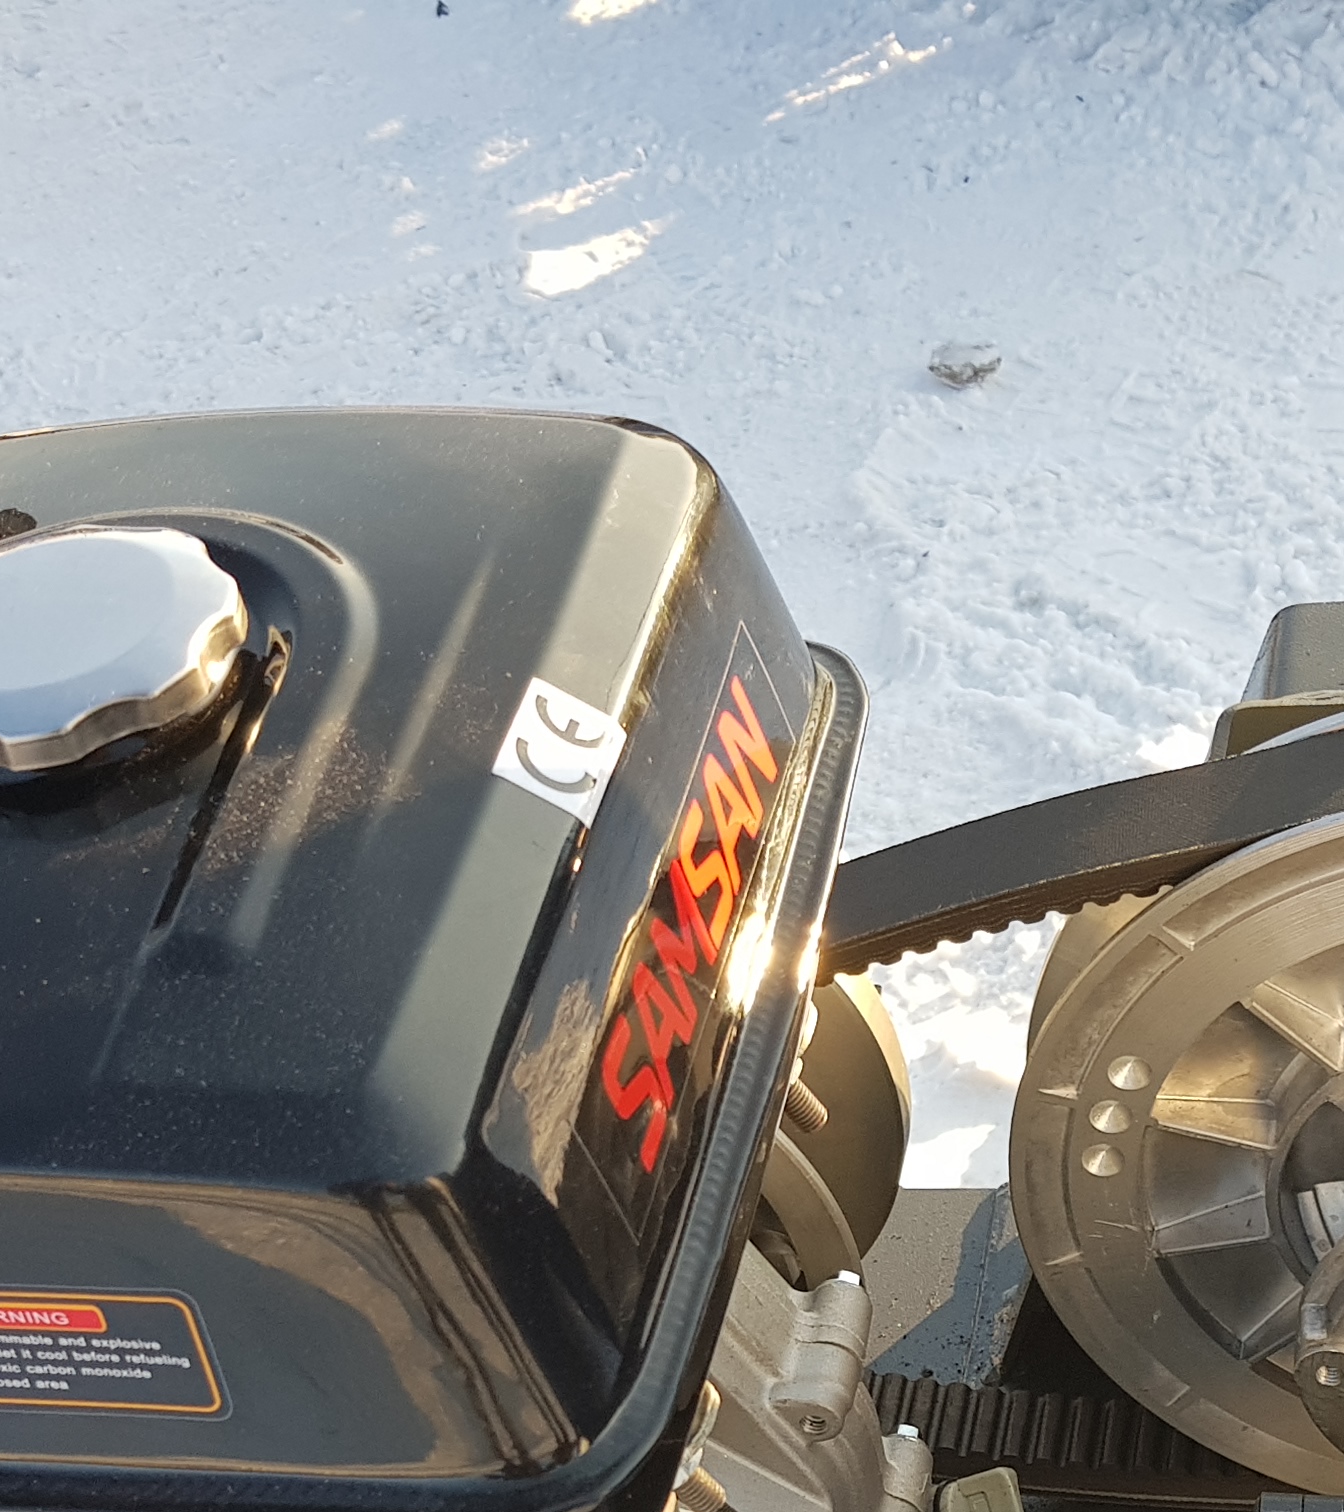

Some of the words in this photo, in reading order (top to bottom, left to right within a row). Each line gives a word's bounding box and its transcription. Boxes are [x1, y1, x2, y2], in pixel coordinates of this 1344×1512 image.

[516, 694, 605, 794] CE
[602, 675, 779, 1174] SAMSAN
[58, 1336, 87, 1347] and
[91, 1337, 161, 1350] explosive
[21, 1348, 33, 1359] it
[37, 1350, 67, 1361] cool
[72, 1351, 121, 1363] before
[26, 1363, 76, 1375] carbon
[81, 1367, 152, 1379] monoxide
[35, 1379, 70, 1390] area
